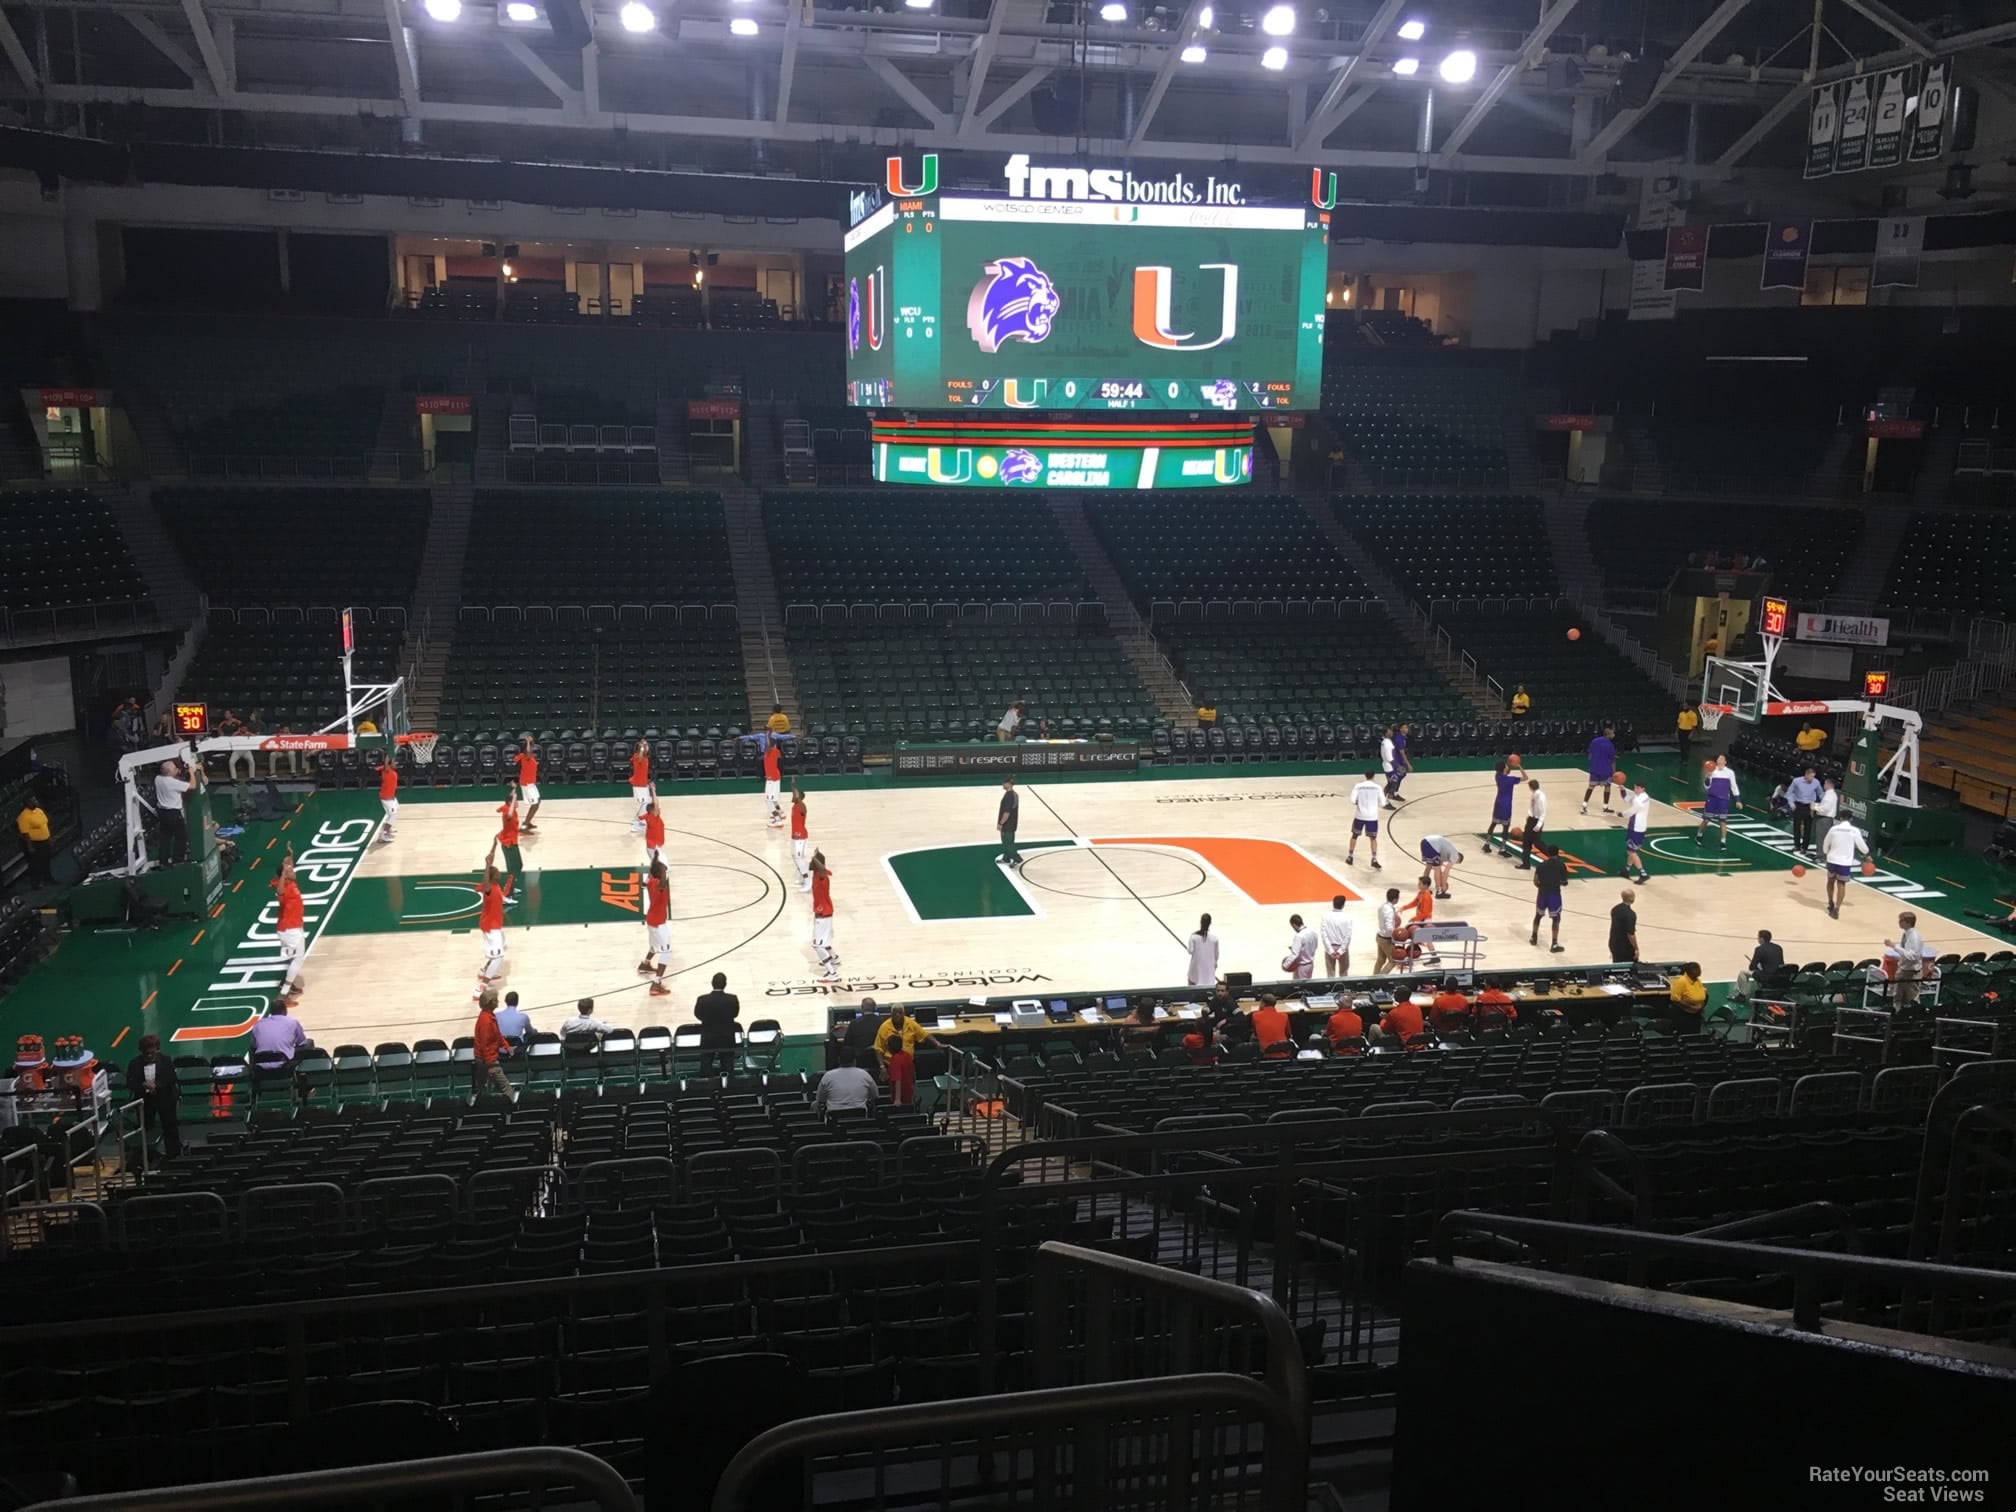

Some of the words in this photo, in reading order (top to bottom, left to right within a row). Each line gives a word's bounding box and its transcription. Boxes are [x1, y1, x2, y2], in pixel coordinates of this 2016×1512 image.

[1925, 88, 1940, 110] 10
[1844, 106, 1867, 125] 24
[1884, 102, 1896, 120] 2
[1817, 113, 1830, 131] 11
[1206, 176, 1246, 205] Inc.
[900, 202, 923, 211] MIAMI
[906, 223, 913, 233] 0
[925, 222, 933, 233] 0
[900, 306, 921, 316] WCU
[906, 327, 913, 338] 0
[925, 327, 933, 338] 0
[948, 381, 973, 389] FOULS
[982, 379, 990, 390] 0
[1065, 381, 1076, 398] 0
[1101, 382, 1143, 398] 59:44
[1167, 382, 1179, 398] 0
[1252, 382, 1260, 393] 2
[1267, 383, 1291, 392] FOULS
[948, 395, 963, 403] TOL
[971, 394, 979, 404] 4
[1108, 400, 1128, 408] HALF
[1261, 396, 1269, 407] 4
[1276, 397, 1290, 405] TOL
[1047, 453, 1107, 469] WESTERN
[1046, 470, 1110, 487] CAROLINA
[1766, 613, 1782, 633] 30
[1869, 683, 1882, 694] 30
[177, 706, 204, 717] 59:44
[182, 717, 200, 730] 30
[601, 871, 640, 913] ACC
